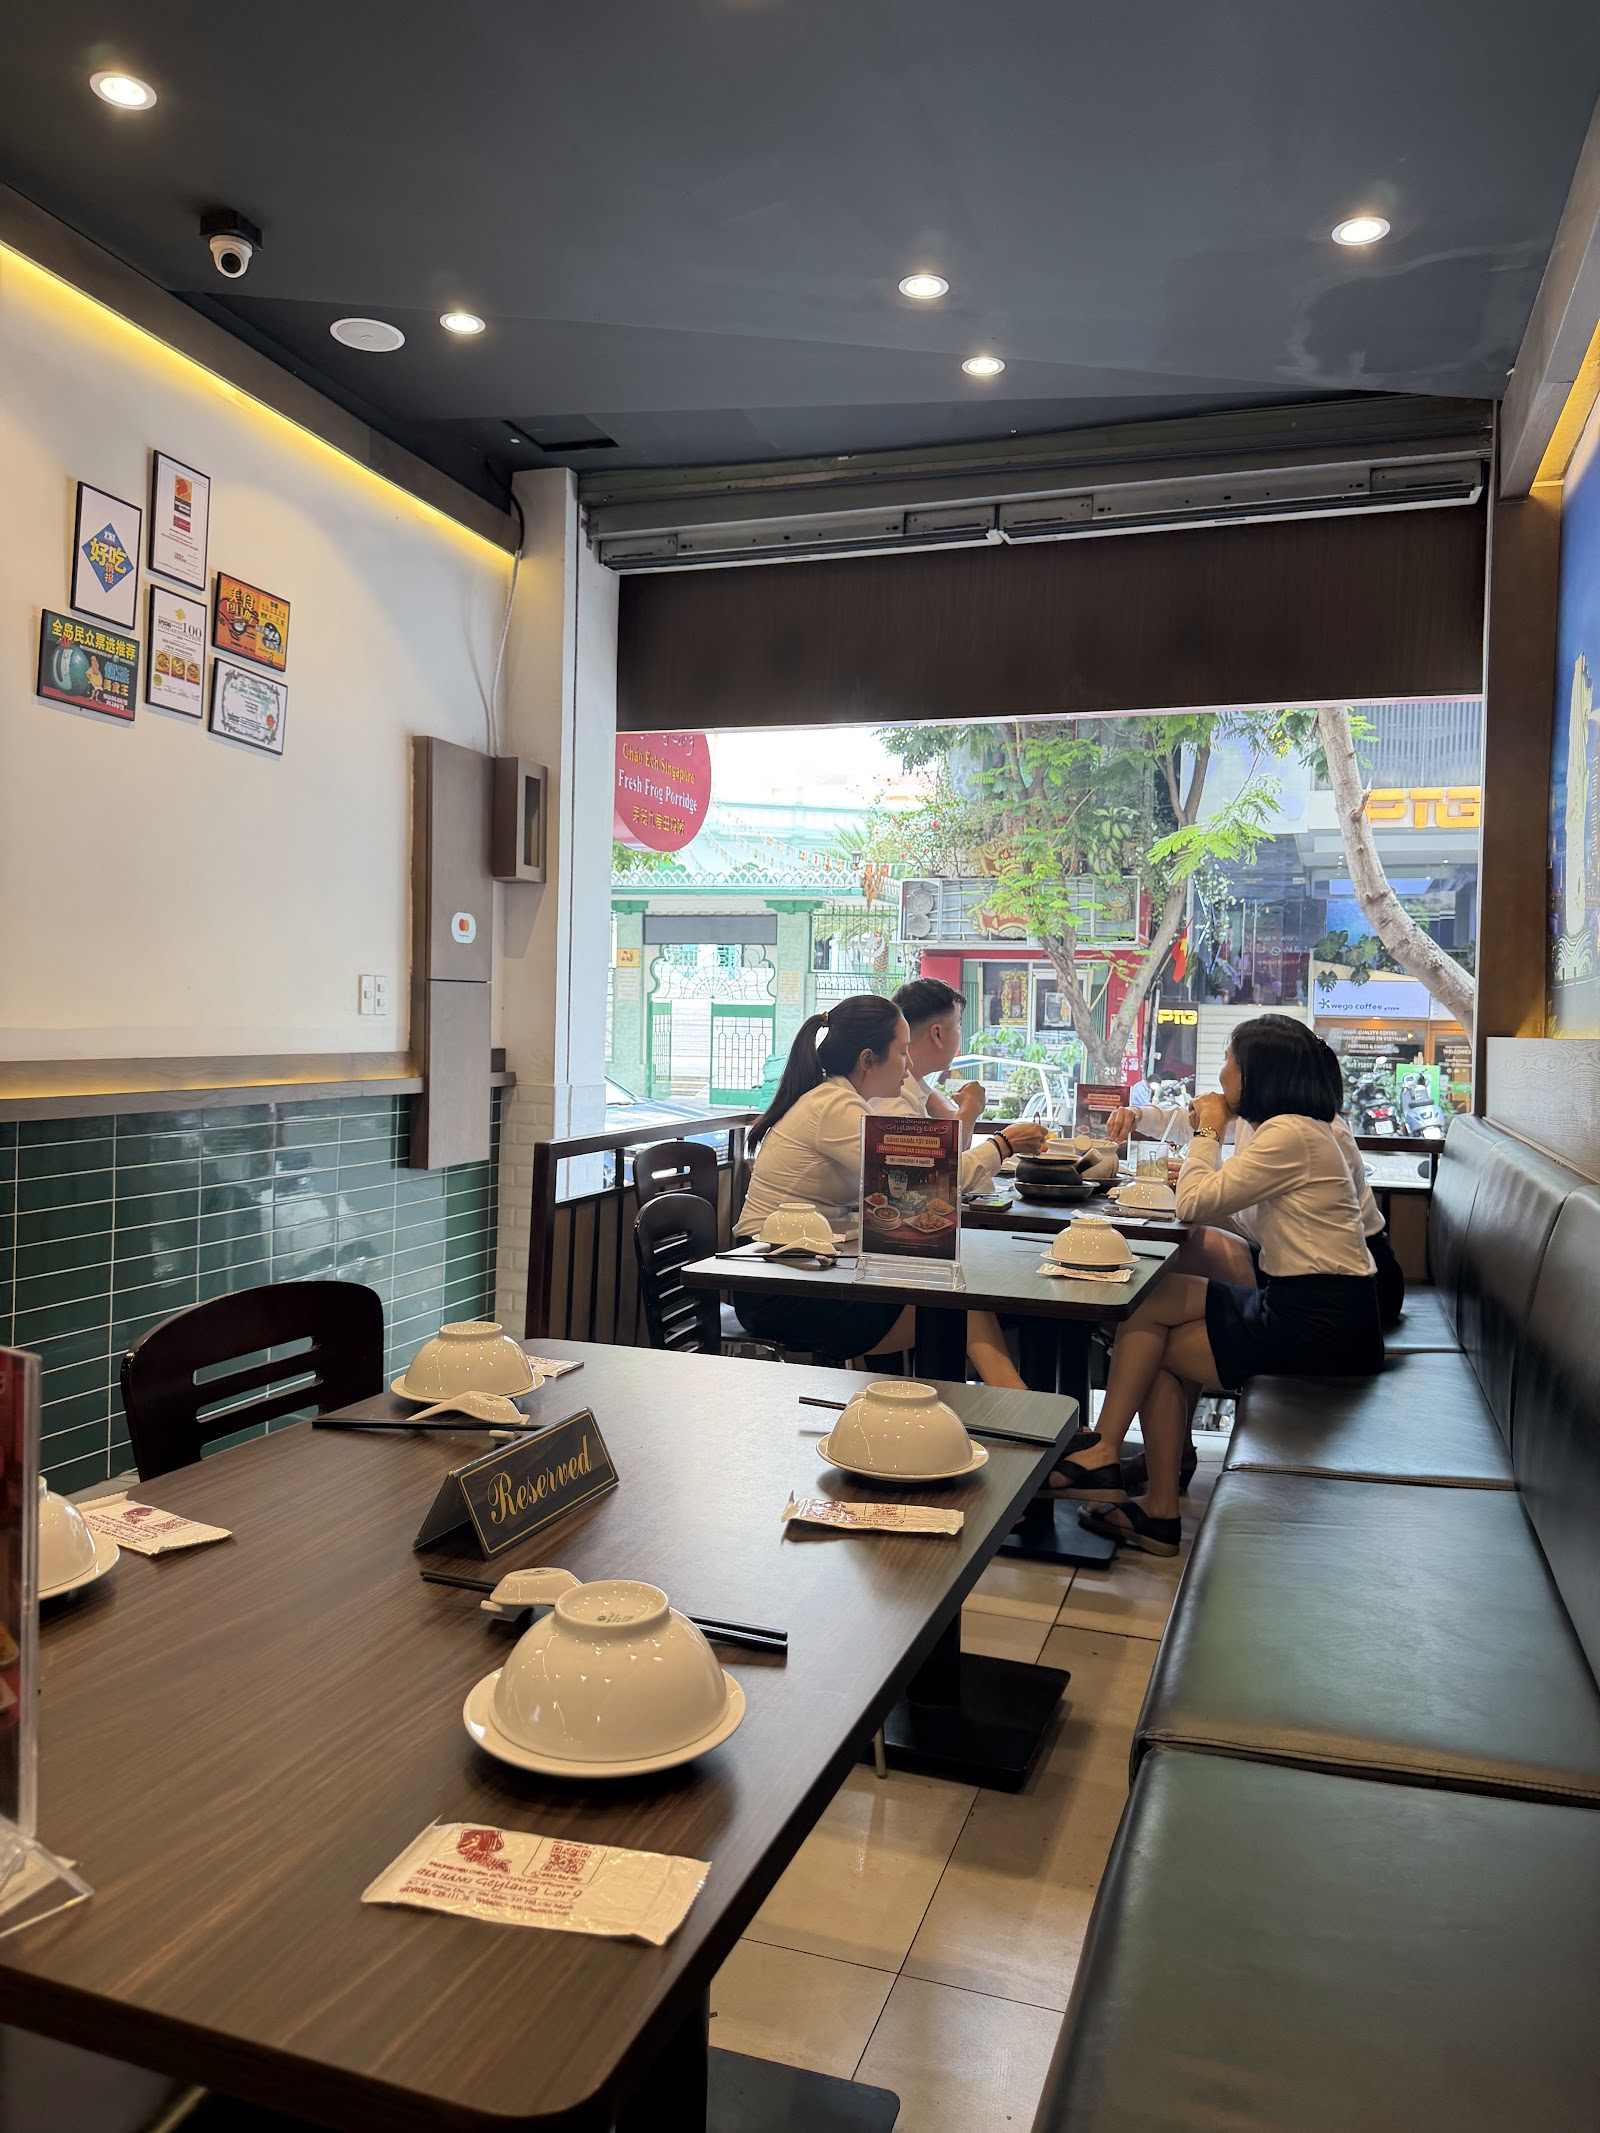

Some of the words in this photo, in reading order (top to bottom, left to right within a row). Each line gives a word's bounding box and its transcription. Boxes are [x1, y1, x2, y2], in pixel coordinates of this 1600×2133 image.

[90, 537, 127, 574] 好吃
[51, 619, 136, 660] 全岛民众票选推荐
[661, 757, 695, 784] Singapore
[618, 768, 643, 793] Fresh
[645, 778, 664, 805] Frog
[665, 785, 698, 815] Porridge
[1157, 1009, 1198, 1025] PTG
[1104, 1067, 1117, 1076] 20
[885, 1124, 923, 1134] Geylang
[487, 1435, 592, 1525] Reserved
[475, 1877, 539, 1896] Geylang
[543, 1887, 571, 1898] Lor
[569, 1889, 583, 1901] 9
